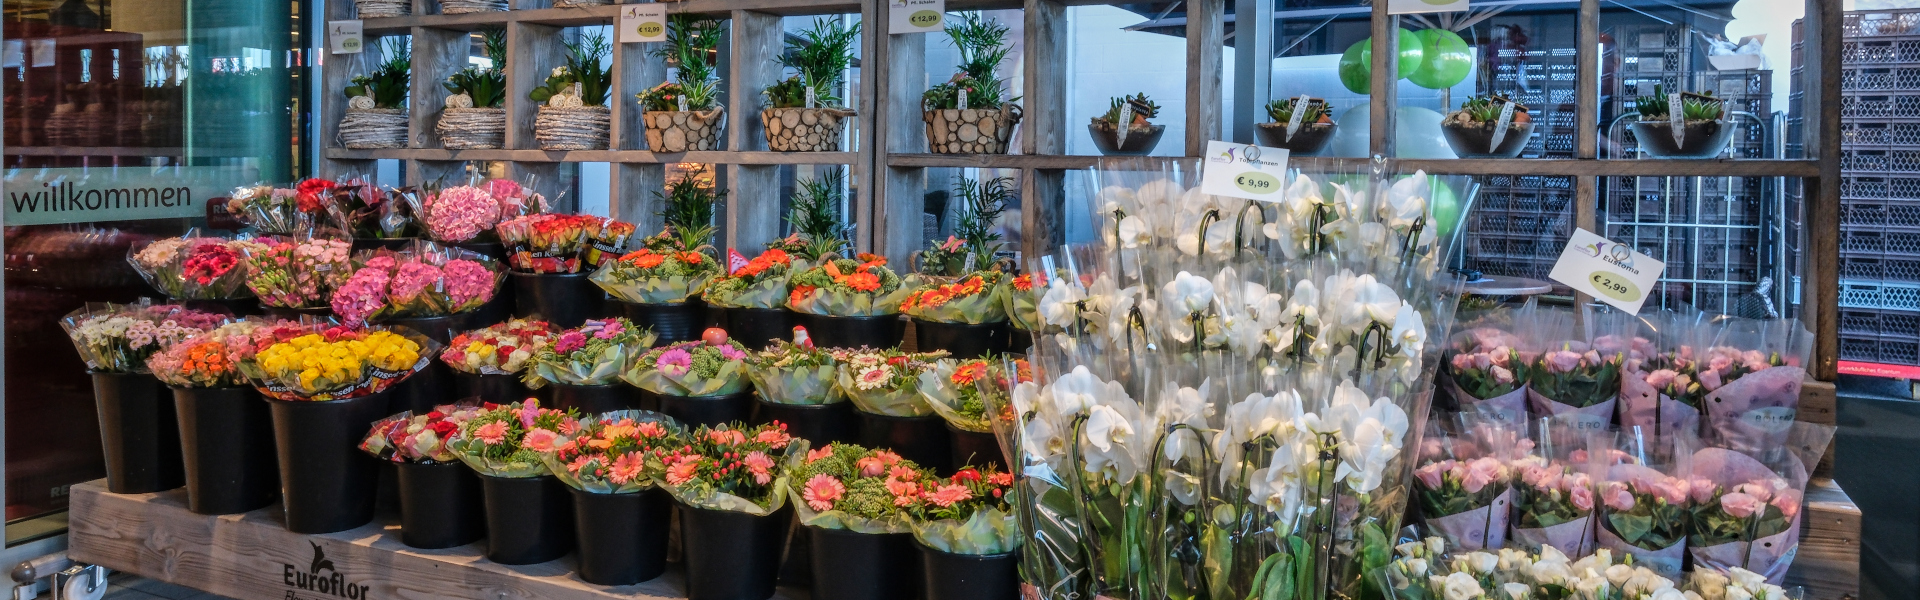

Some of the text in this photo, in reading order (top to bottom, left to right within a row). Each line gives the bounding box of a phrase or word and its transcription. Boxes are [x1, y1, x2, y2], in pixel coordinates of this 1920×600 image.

[1237, 176, 1270, 188] € 9,99
[10, 181, 191, 213] willkommen
[1602, 254, 1640, 275] Eustoma
[1593, 274, 1628, 294] € 2,99
[50, 484, 69, 498] RE
[284, 563, 370, 600] Euroflor
